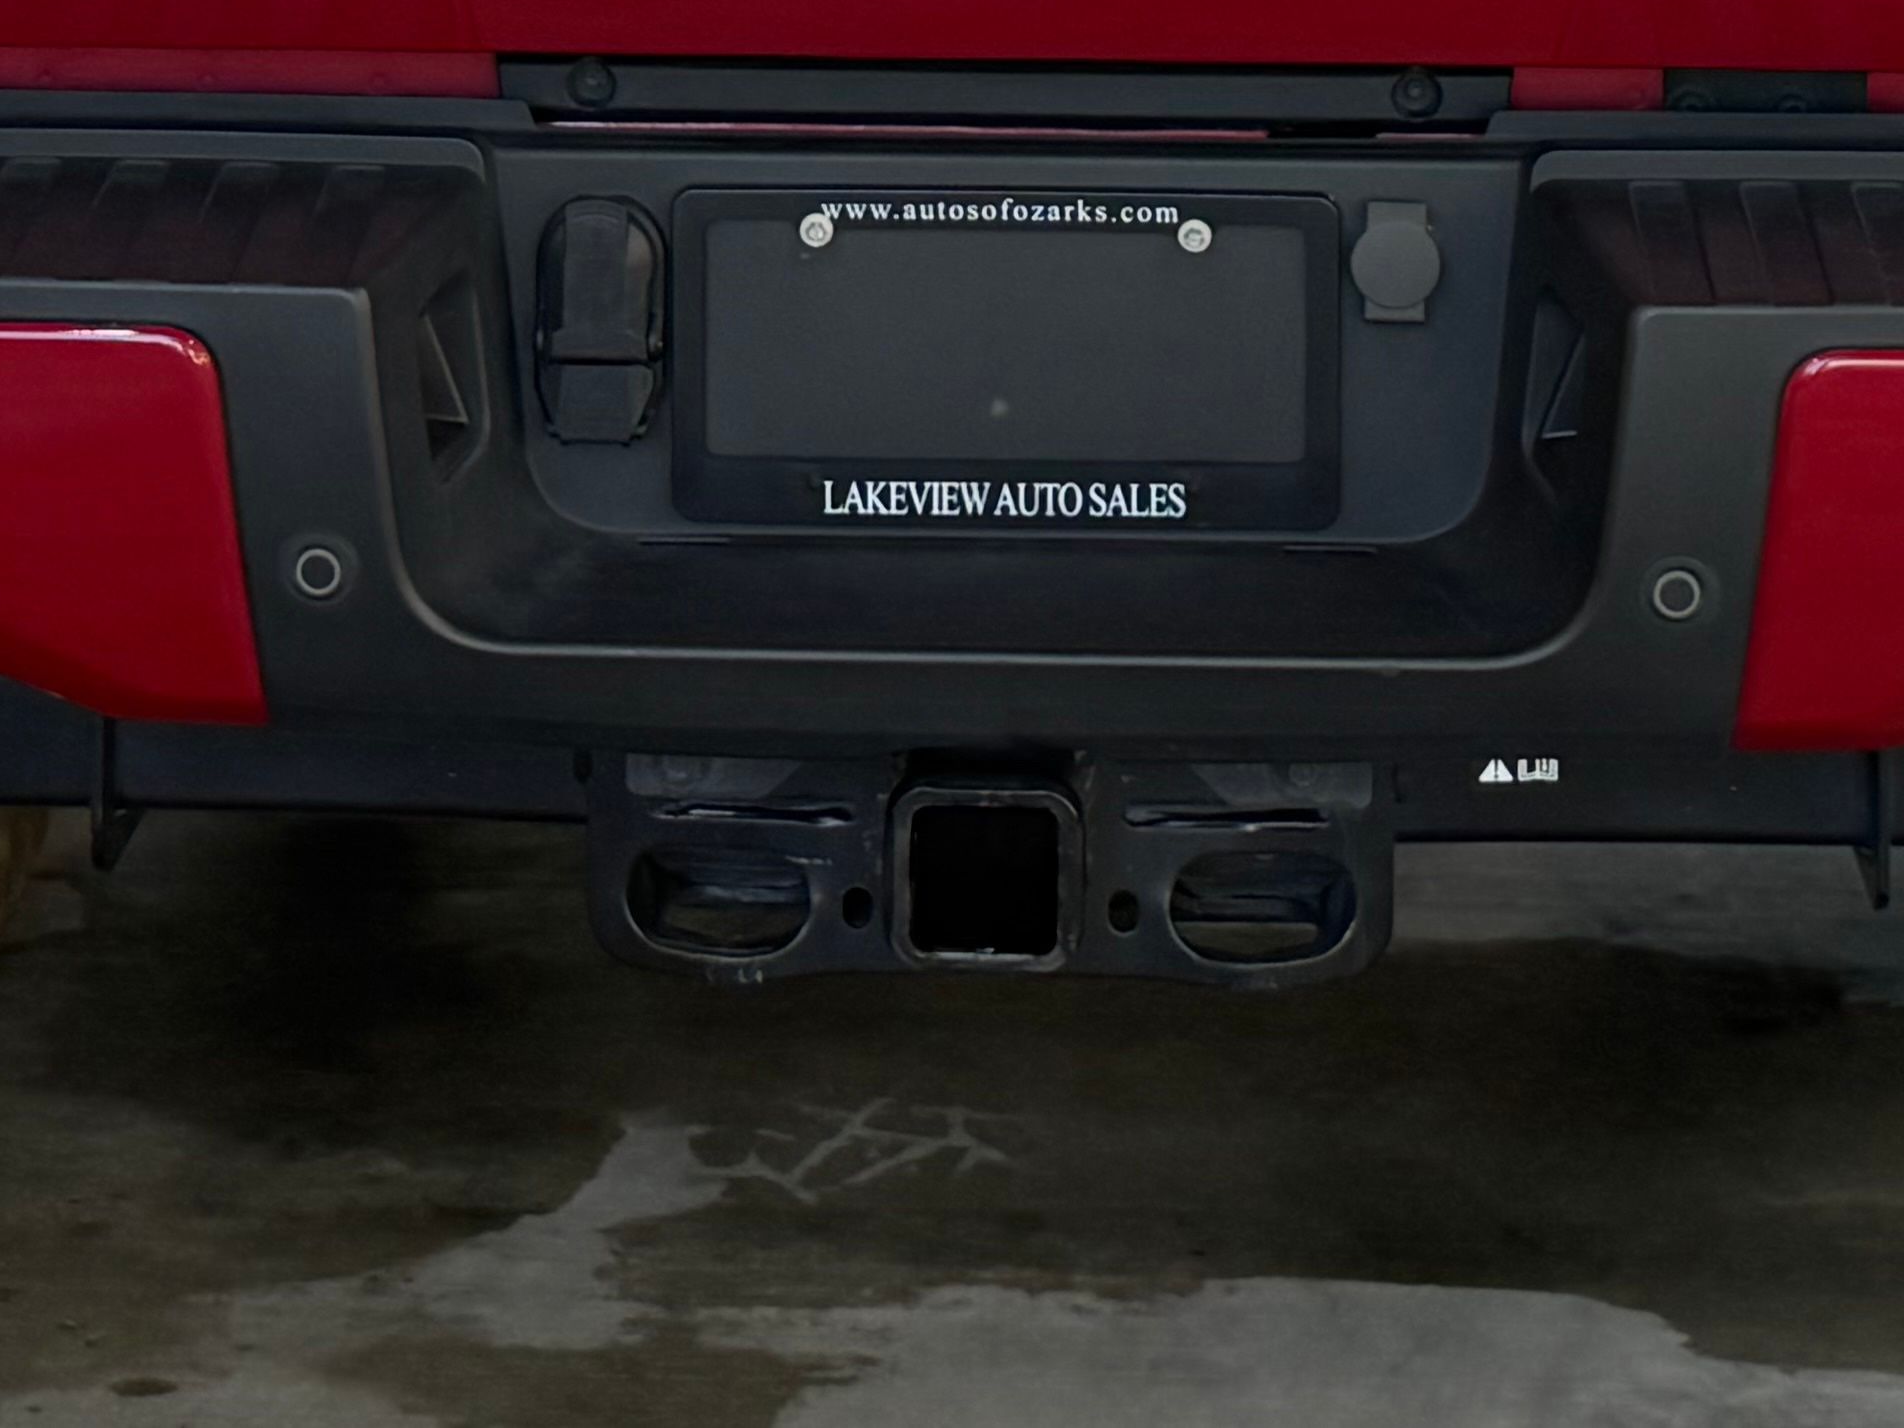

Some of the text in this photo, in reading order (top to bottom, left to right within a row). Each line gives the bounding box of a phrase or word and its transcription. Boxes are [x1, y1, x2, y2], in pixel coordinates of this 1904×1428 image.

[821, 197, 1179, 224] www.autosofozarks.com
[823, 480, 1187, 518] LAKEVIEW AUTO SALES
